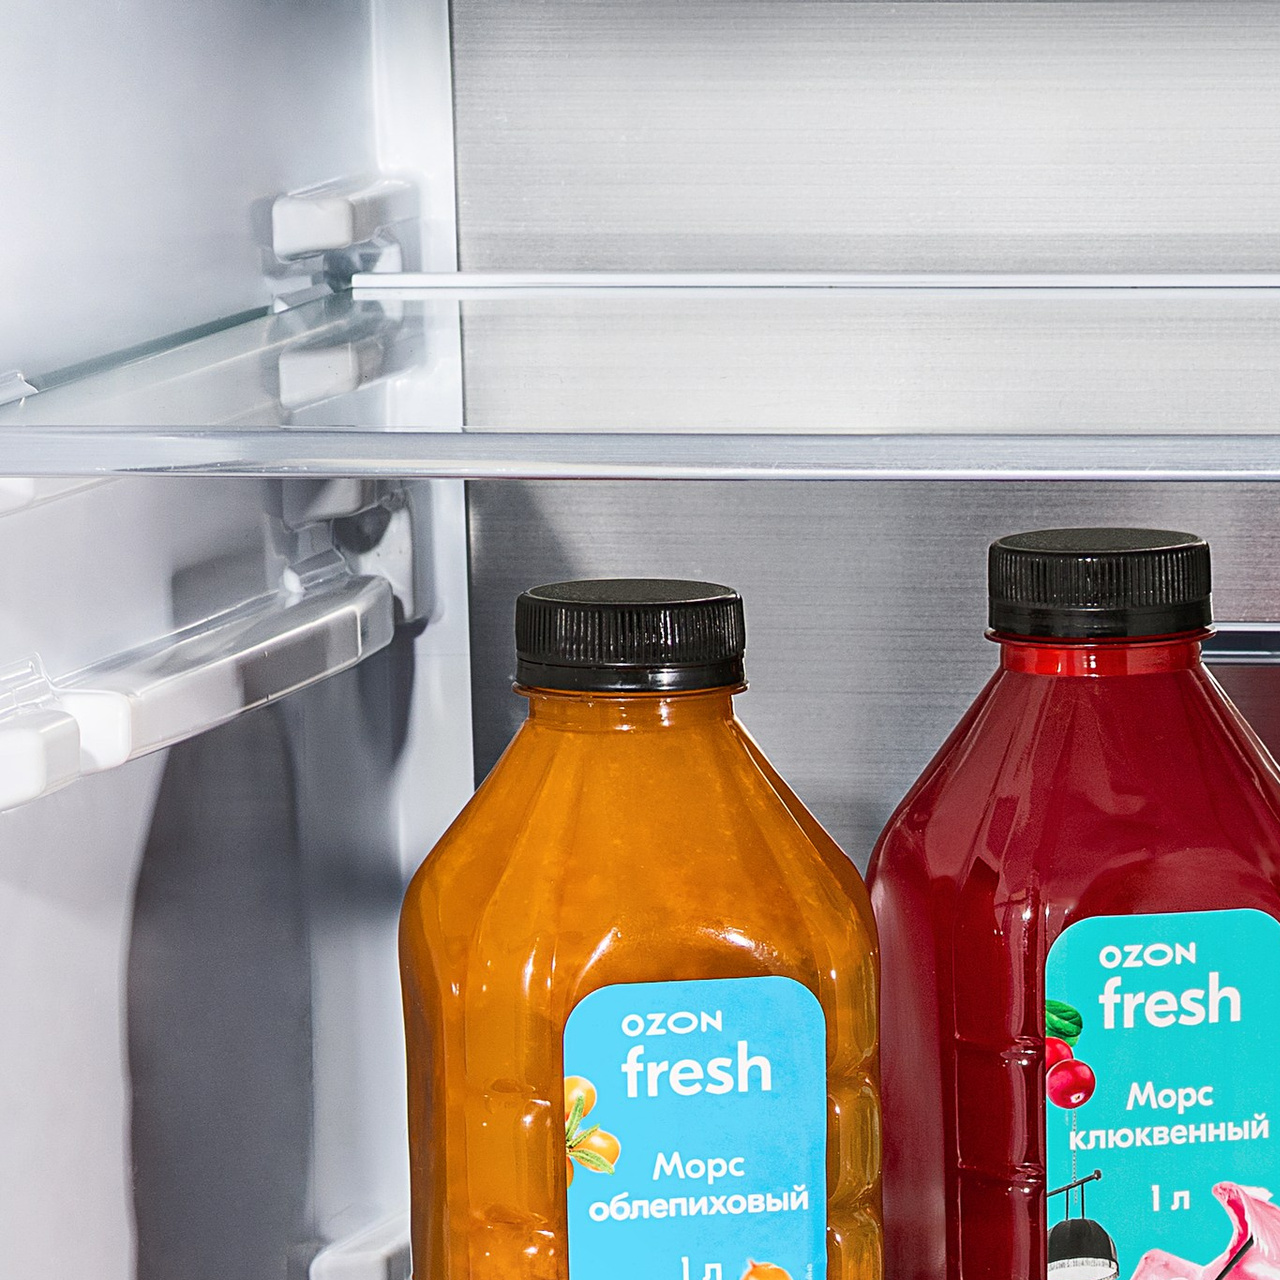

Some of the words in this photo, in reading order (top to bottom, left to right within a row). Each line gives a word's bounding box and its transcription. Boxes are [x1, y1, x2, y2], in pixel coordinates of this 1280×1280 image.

[1099, 942, 1196, 968] OZON
[1099, 972, 1241, 1029] fresh
[622, 1010, 722, 1036] OZON
[621, 1041, 771, 1097] fresh
[1126, 1081, 1213, 1114] Морс
[1069, 1112, 1270, 1151] клюквенный
[653, 1152, 744, 1184] Морс
[588, 1184, 809, 1222] облепиховый
[1152, 1185, 1159, 1211] 1
[1171, 1191, 1189, 1210] л
